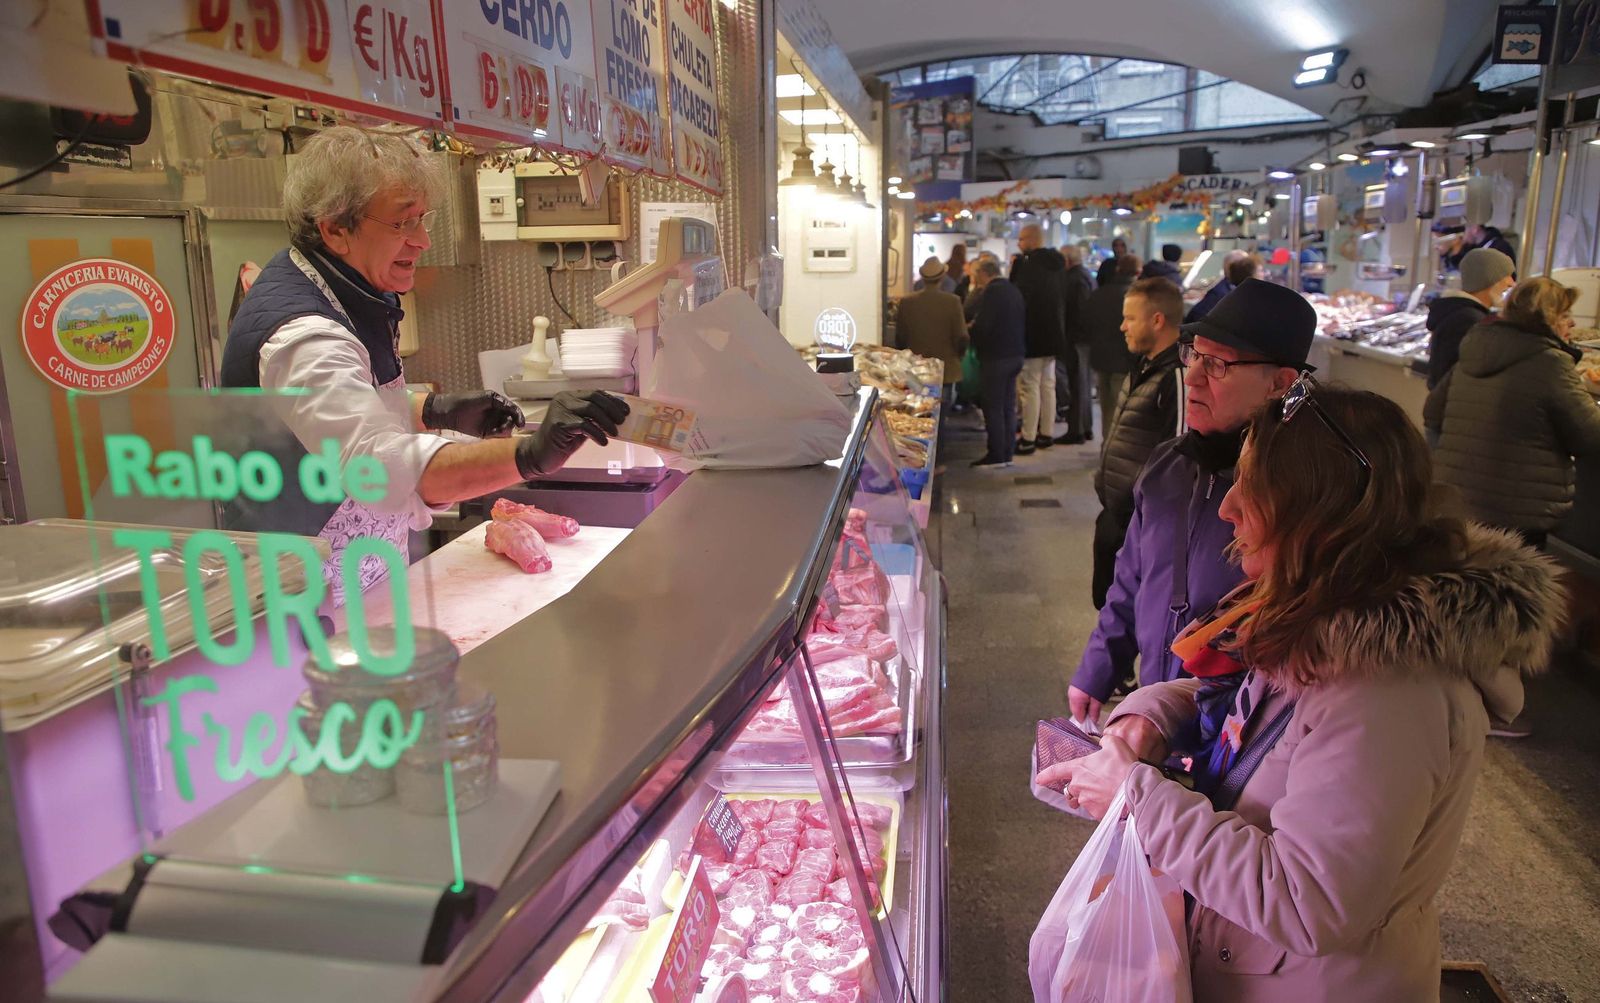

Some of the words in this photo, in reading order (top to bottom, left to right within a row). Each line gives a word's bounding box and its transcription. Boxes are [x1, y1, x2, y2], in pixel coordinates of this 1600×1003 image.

[353, 4, 436, 98] €/Kg
[611, 0, 651, 67] LOMO
[671, 21, 713, 93] CHULETA
[605, 48, 659, 119] FRESCA
[33, 266, 107, 329] CARNICERIA
[107, 266, 164, 313] EVARISTO
[48, 356, 89, 387] CARNE
[91, 375, 107, 388] DE
[108, 335, 166, 387] CAMPEONES
[104, 434, 283, 501] Rabo
[299, 438, 390, 504] de
[112, 529, 416, 677] TORO
[142, 674, 425, 802] Fresco
[665, 889, 706, 991] TORO
